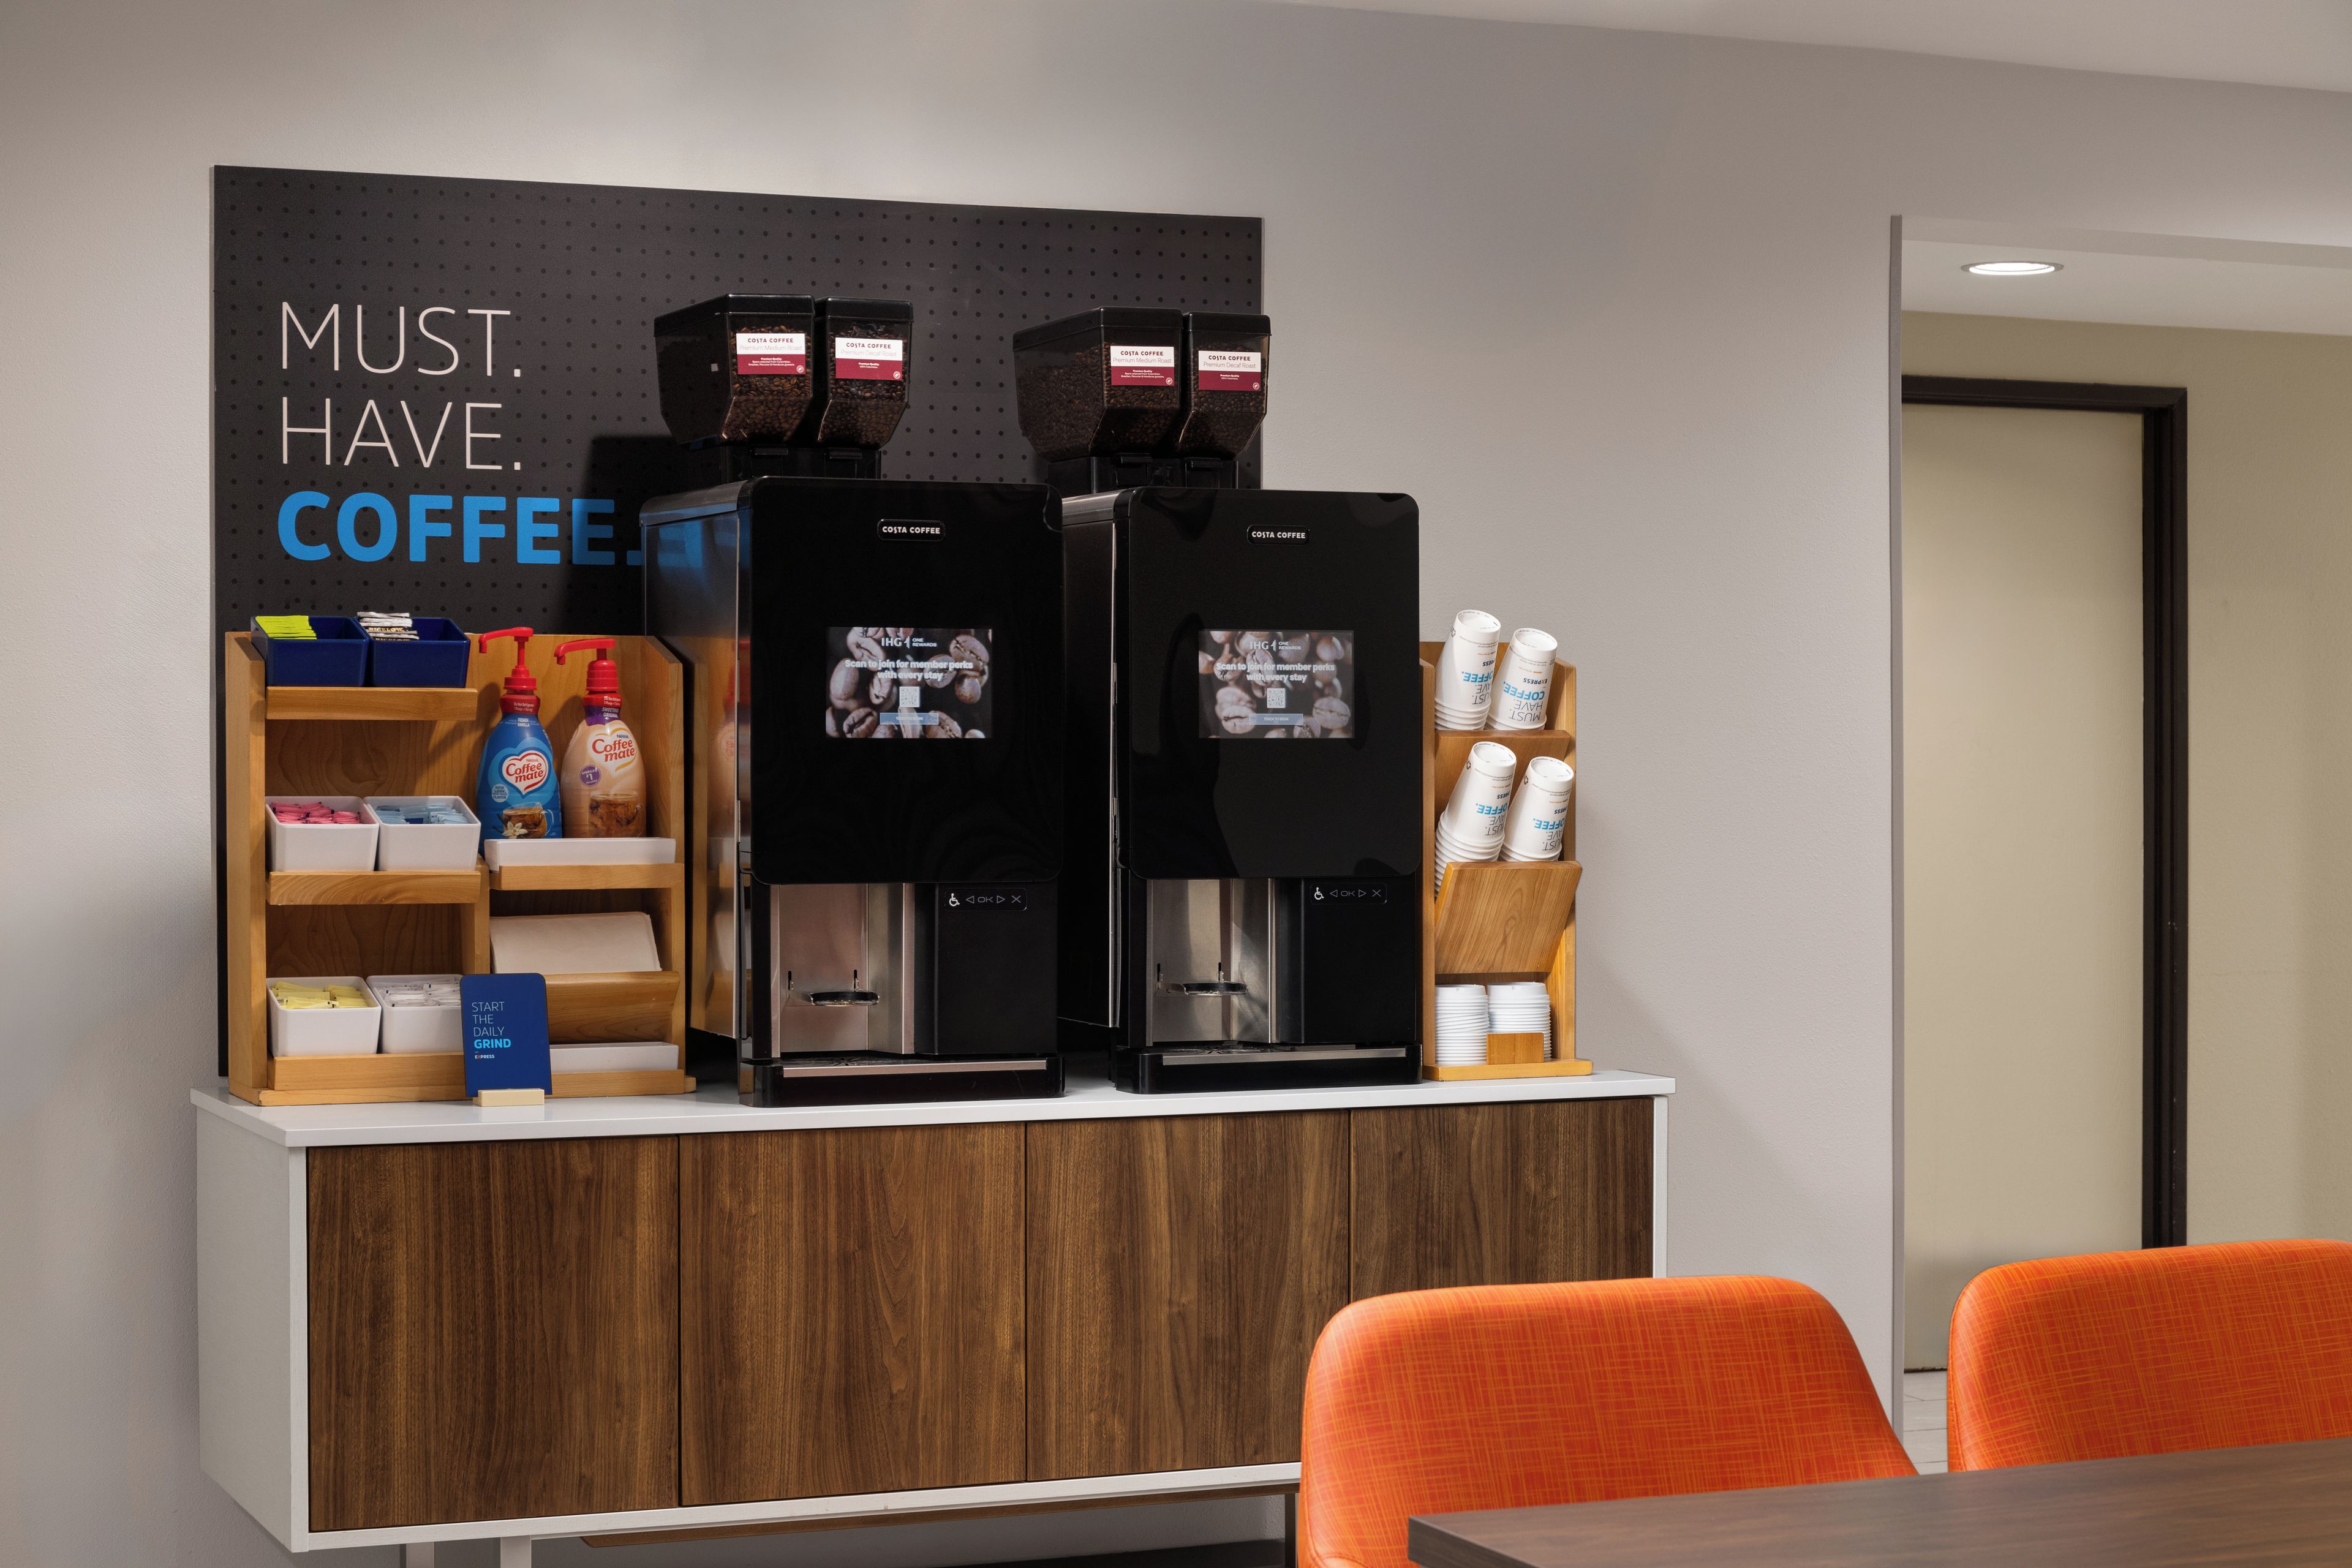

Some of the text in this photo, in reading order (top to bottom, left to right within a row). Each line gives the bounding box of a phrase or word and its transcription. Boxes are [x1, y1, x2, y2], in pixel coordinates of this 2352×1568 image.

[282, 301, 521, 377] MUST.
[282, 397, 521, 471] HAVE.
[277, 491, 642, 565] COFFEE.
[881, 637, 903, 647] IHG
[1250, 641, 1268, 650] IHG
[878, 659, 895, 670] join
[896, 660, 910, 668] for
[910, 660, 948, 669] member
[949, 661, 974, 671] perks
[1247, 662, 1262, 672] join
[1264, 662, 1276, 671] for
[1313, 663, 1335, 673] perks
[897, 673, 923, 681] every
[924, 672, 944, 681] stay
[1265, 674, 1289, 683] every
[1289, 674, 1308, 683] stay
[1461, 670, 1493, 683] OFFEE.
[1476, 683, 1491, 694] AVE.
[1503, 681, 1545, 701] COFFEE.
[1472, 692, 1490, 704] UST.
[1513, 699, 1544, 711] HAVE.
[1509, 709, 1541, 722] MUST.
[592, 739, 633, 754] Coffee
[605, 747, 635, 762] mate
[506, 763, 542, 777] Coffee
[515, 770, 543, 783] mate
[1476, 802, 1507, 815] OFFEE.
[1488, 815, 1505, 825] AVE.
[1533, 818, 1565, 830] OFFEE.
[1485, 823, 1503, 835] UST.
[1546, 830, 1562, 840] AVE.
[1542, 839, 1560, 851] UST.
[472, 1001, 505, 1012] START
[472, 1014, 494, 1024] THE
[473, 1027, 505, 1037] DAILY
[473, 1038, 511, 1049] GRIND
